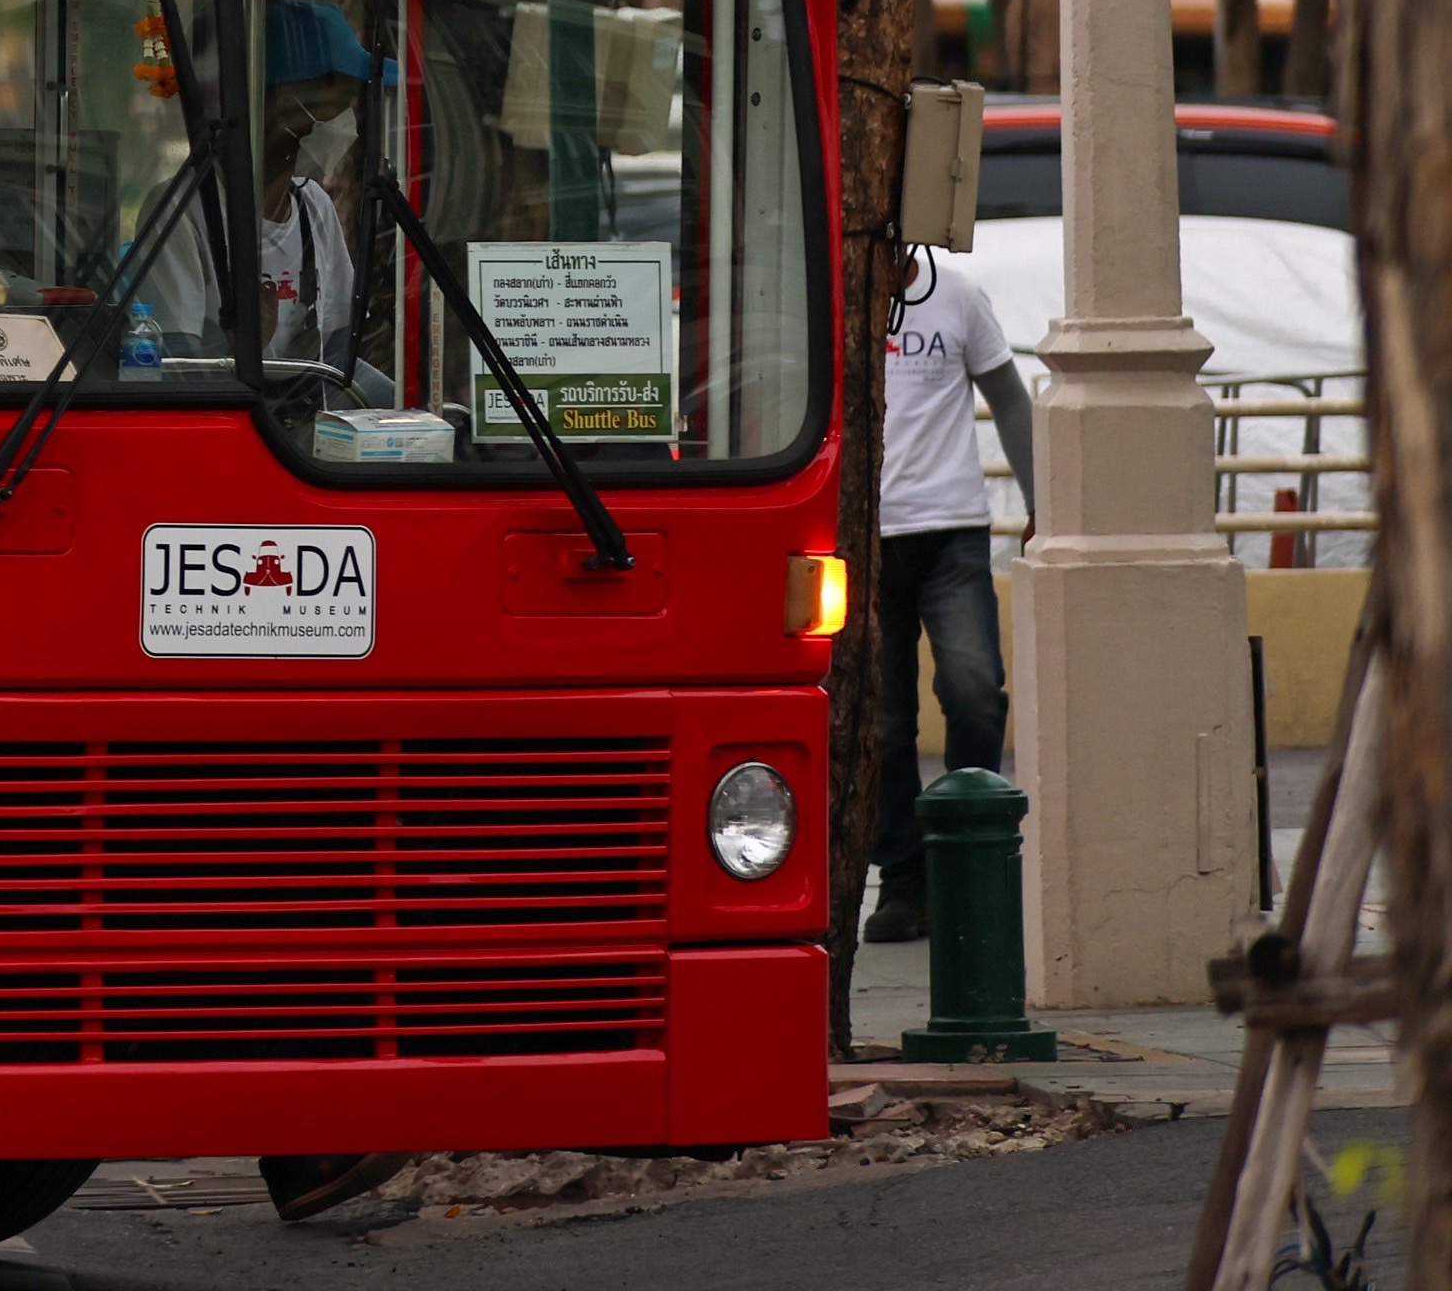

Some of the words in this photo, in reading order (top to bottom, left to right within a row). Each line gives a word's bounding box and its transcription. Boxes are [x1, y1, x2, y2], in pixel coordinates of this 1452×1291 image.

[545, 248, 597, 270] เส้นทาง
[559, 380, 660, 403] รถบริการรับ-ส่ง
[563, 409, 621, 430] Shuttle
[626, 409, 657, 430] Bus
[150, 604, 247, 615] TECHNIK
[282, 605, 367, 616] MUSEUM
[149, 621, 366, 640] www.jesadatechnikmuseum.com
